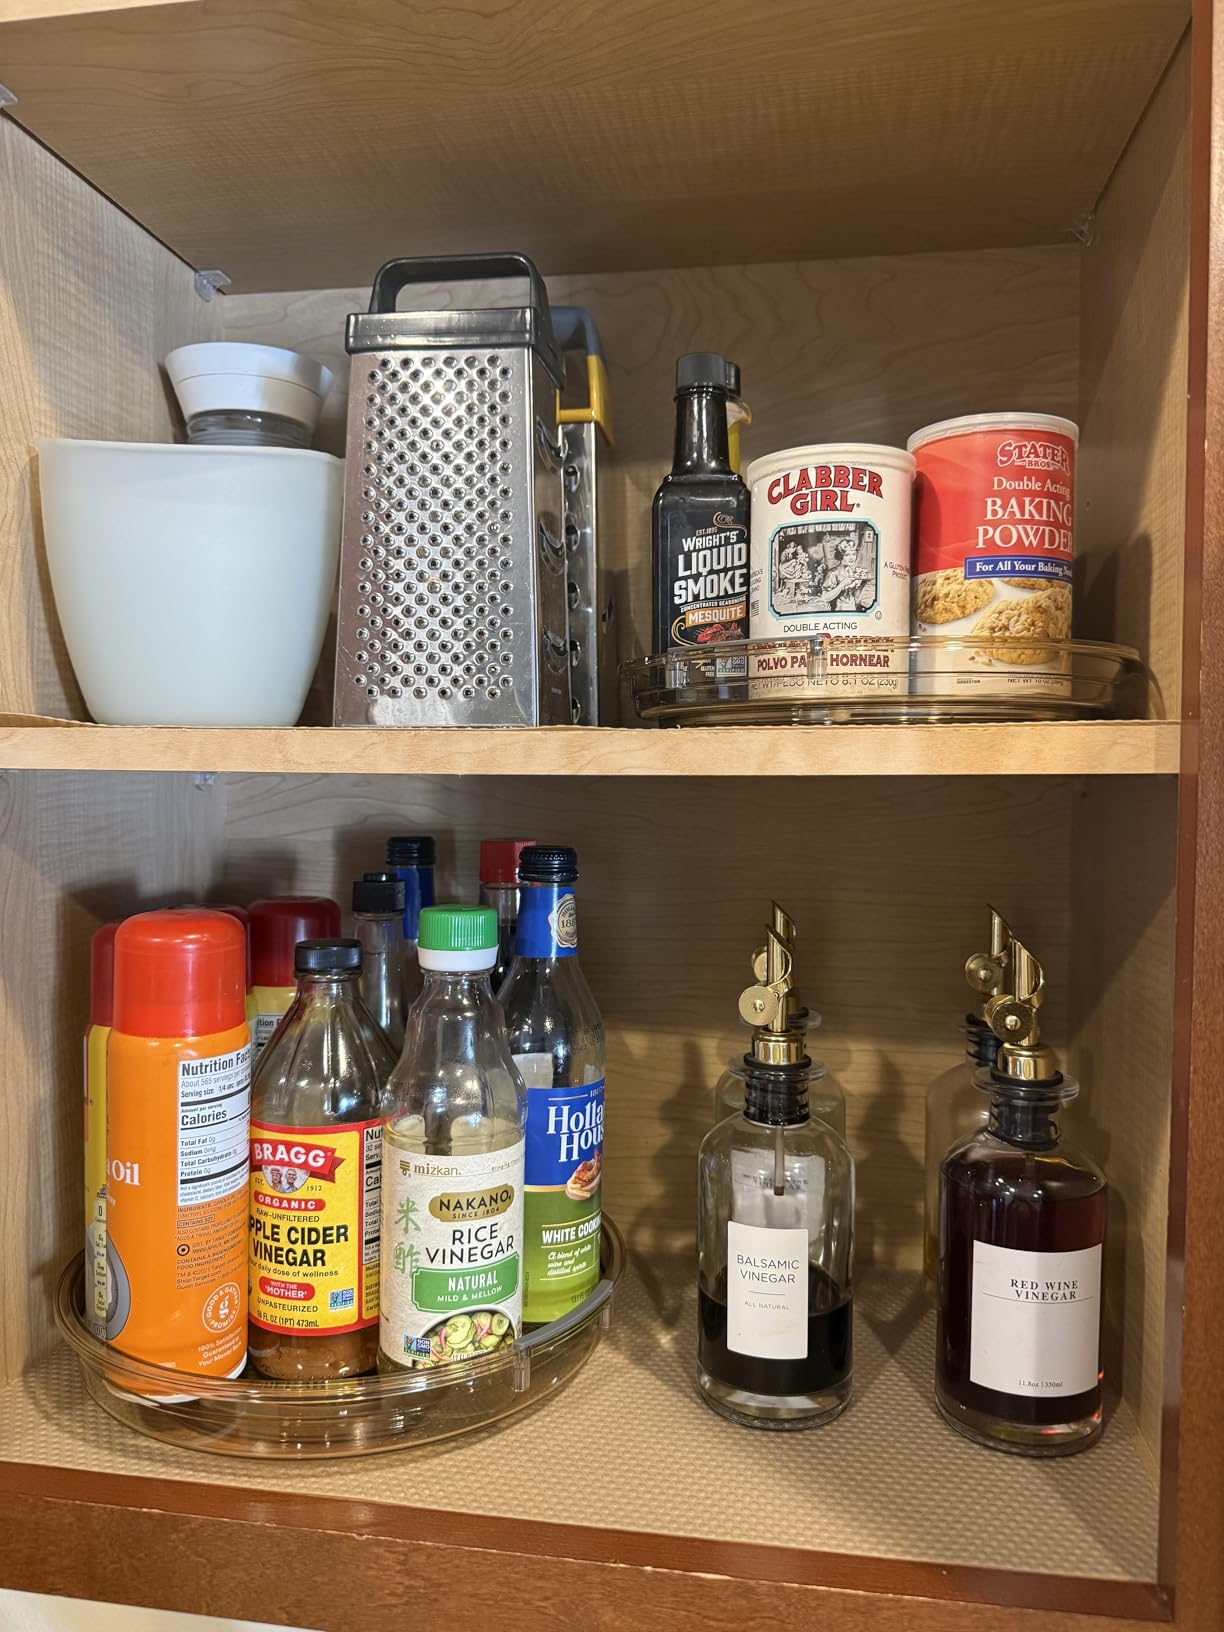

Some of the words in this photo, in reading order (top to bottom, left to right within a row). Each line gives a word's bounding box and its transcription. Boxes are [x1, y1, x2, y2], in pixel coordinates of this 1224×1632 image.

[997, 440, 1070, 476] STATER
[767, 465, 884, 505] CLABBER
[993, 476, 1042, 491] Double
[1044, 479, 1070, 500] Acting
[790, 489, 855, 516] GIRL
[984, 497, 1072, 526] BAKING
[678, 543, 747, 577] LIQUID
[976, 562, 993, 572] For
[996, 561, 1011, 571] All
[1014, 561, 1035, 571] Your
[1038, 562, 1063, 576] Baking
[674, 568, 748, 605] SMOKE
[688, 605, 744, 624] MESQUITE
[783, 623, 820, 633] DOUBLE
[823, 622, 857, 631] ACTING
[757, 656, 788, 672] POLVO
[791, 656, 808, 669] PA
[830, 653, 890, 668] HORNEAR
[181, 1058, 234, 1077] Nutrition
[181, 1080, 200, 1088] About
[181, 1089, 203, 1099] Serving
[203, 1088, 215, 1096] size
[181, 1110, 227, 1126] Calories
[546, 1100, 604, 1134] Holla
[181, 1139, 196, 1147] Total
[181, 1149, 203, 1157] Sodium
[198, 1151, 232, 1165] Carbohydrate
[254, 1143, 325, 1167] BRAGG
[111, 1159, 141, 1186] Oil
[181, 1169, 203, 1177] Protein
[255, 1177, 264, 1186] EST.
[258, 1195, 316, 1209] ORGANIC
[365, 1199, 378, 1208] Total
[256, 1207, 320, 1222] RAW-UNFILTERED
[453, 1211, 478, 1219] SINCE
[483, 1207, 500, 1216] 1804
[178, 1219, 203, 1228] CONTAINS
[249, 1215, 280, 1243] PPLE
[287, 1224, 349, 1245] CIDER
[365, 1219, 378, 1228] Total
[452, 1222, 499, 1245] RICE
[542, 1226, 576, 1244] WHITE
[253, 1238, 326, 1267] VINEGAR
[425, 1235, 514, 1265] VINEGAR
[557, 1249, 573, 1259] blend
[574, 1247, 580, 1257] of
[177, 1255, 206, 1264] CONTAINS
[547, 1260, 562, 1268] wine
[563, 1257, 575, 1266] and
[737, 1254, 800, 1270] BALSAMIC
[257, 1263, 271, 1274] daily
[273, 1266, 290, 1276] dose
[547, 1266, 571, 1276] distilled
[740, 1269, 796, 1284] VINEGAR
[271, 1280, 285, 1289] WITH
[448, 1270, 498, 1292] NATURAL
[1010, 1278, 1039, 1290] RED
[1045, 1280, 1078, 1291] WINE
[471, 1285, 503, 1300] MELLOW
[1015, 1289, 1077, 1301] VINEGAR
[206, 1294, 219, 1318] GOOD
[257, 1296, 319, 1313] UNPASTEURIZED
[744, 1300, 757, 1308] ALL
[758, 1303, 790, 1311] NATURAL
[263, 1312, 269, 1321] FL
[270, 1314, 278, 1323] OZ
[279, 1316, 295, 1327] (1PT)
[296, 1319, 319, 1328] 473mL
[198, 1358, 213, 1368] Your
[214, 1349, 232, 1361] Money
